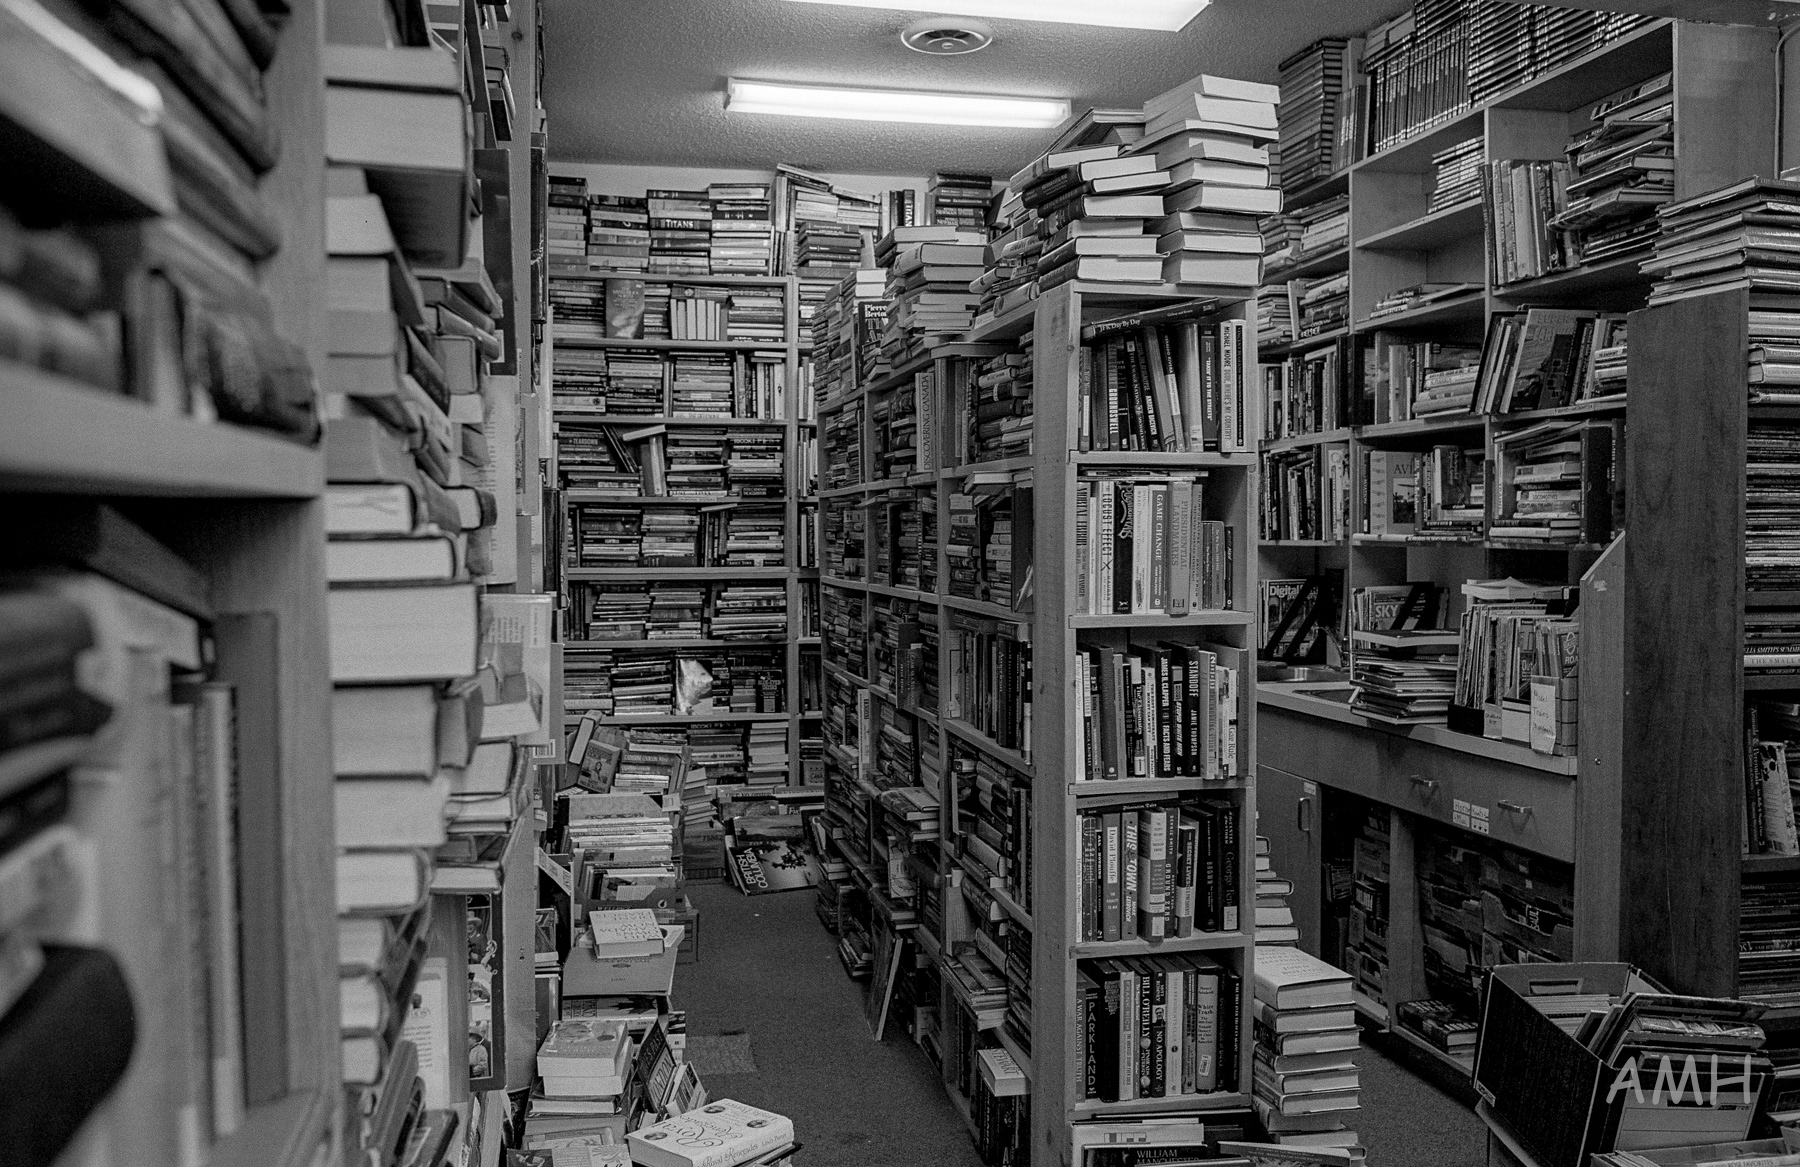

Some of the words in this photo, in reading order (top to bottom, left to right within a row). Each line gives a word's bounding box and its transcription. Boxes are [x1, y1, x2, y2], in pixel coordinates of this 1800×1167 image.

[666, 219, 693, 228] TITANS
[1099, 324, 1111, 333] JFK
[1112, 321, 1122, 330] Day
[1122, 319, 1130, 328] By
[1130, 318, 1141, 326] Day
[922, 375, 930, 412] CANADA
[1109, 389, 1118, 434] GROUNDSWELL
[923, 414, 931, 470] DISCOVERING
[1103, 494, 1112, 524] LOCUST
[1156, 494, 1164, 521] GAME
[1102, 529, 1112, 556] EFFECT
[1155, 523, 1163, 561] CHANGE
[1172, 505, 1180, 567] LANDMARKS
[1180, 501, 1188, 570] PRESIDENTIAL
[1270, 585, 1299, 598] Digital
[1374, 604, 1397, 618] SKY
[1189, 661, 1199, 697] STANDOFF
[1163, 755, 1171, 771] FEARS
[1228, 744, 1236, 759] Rule
[1109, 829, 1117, 850] David
[1127, 824, 1137, 850] THIS
[736, 855, 757, 884] BRITISH
[744, 848, 768, 889] COLUMBIA
[1108, 854, 1117, 881] Plouffe
[1126, 859, 1137, 891] TOWN
[1225, 852, 1235, 885] George
[1142, 976, 1151, 997] BILL
[1142, 999, 1150, 1037] O'REILLY
[1088, 1001, 1097, 1085] PARKLAND
[1156, 1031, 1163, 1043] NO
[1137, 1149, 1177, 1158] WILLIAM
